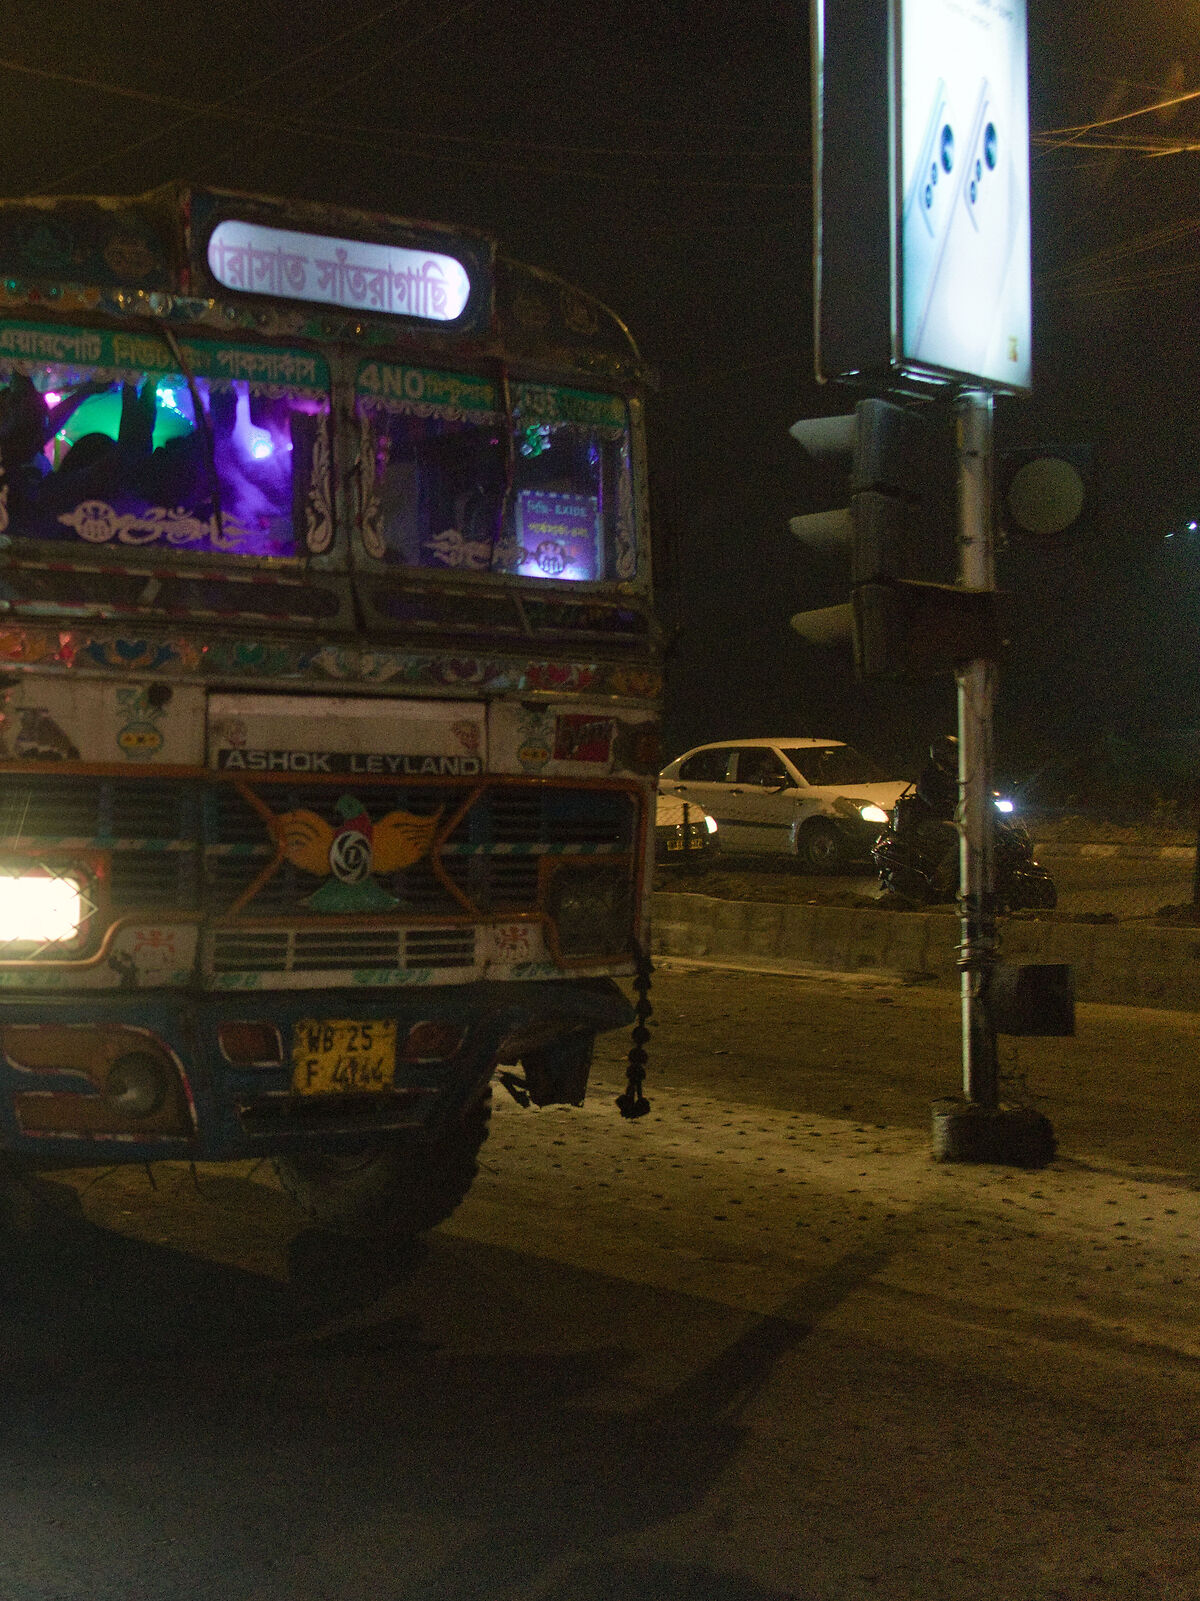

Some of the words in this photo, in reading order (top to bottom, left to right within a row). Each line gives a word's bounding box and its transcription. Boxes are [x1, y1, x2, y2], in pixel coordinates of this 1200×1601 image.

[209, 238, 308, 294] ারাসাত
[225, 750, 332, 772] ASHOK
[350, 755, 481, 776] LEYLAND
[307, 1025, 334, 1053] WB
[347, 1024, 373, 1051] 25
[306, 1059, 319, 1087] F
